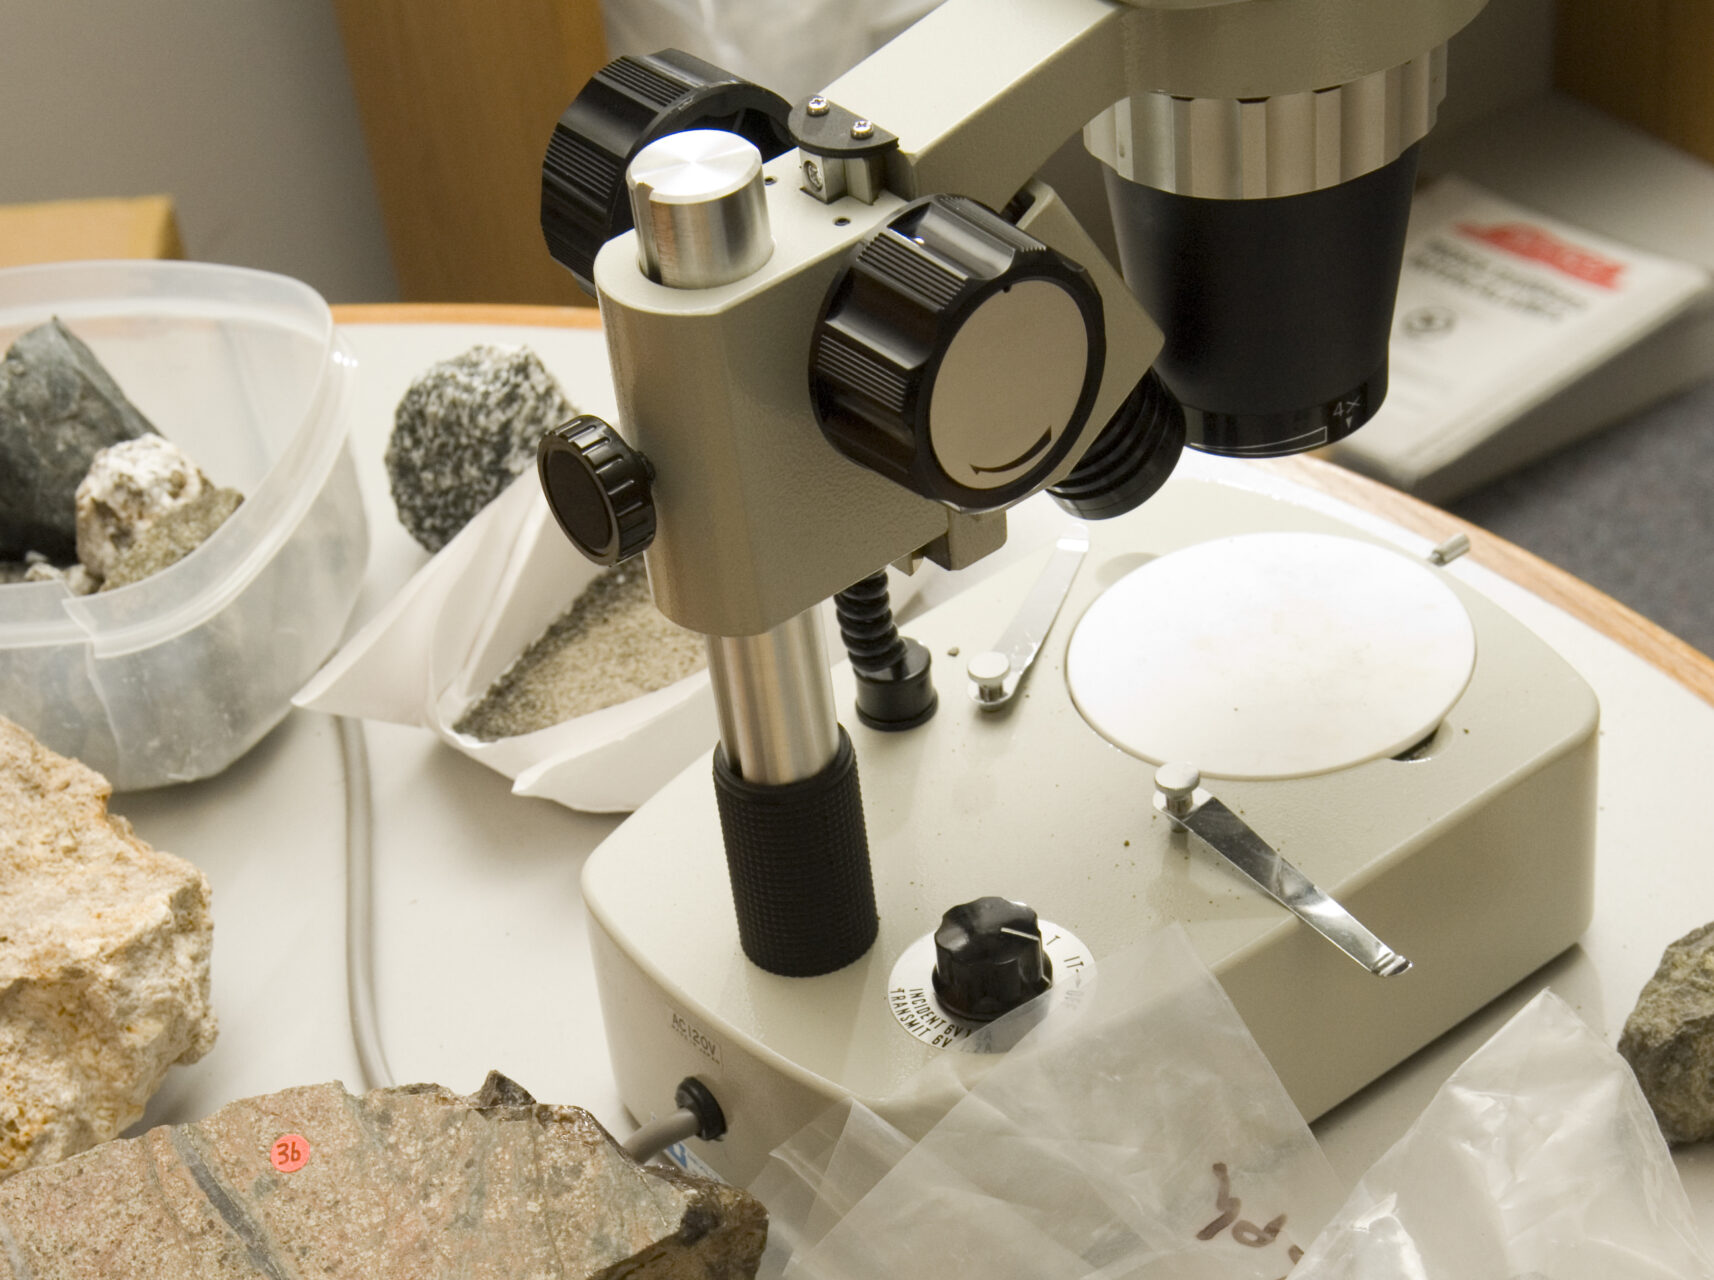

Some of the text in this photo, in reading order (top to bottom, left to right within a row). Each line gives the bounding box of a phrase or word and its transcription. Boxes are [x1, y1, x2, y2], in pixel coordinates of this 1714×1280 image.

[890, 988, 952, 1048] TRANSMIT 6V
[909, 988, 946, 1029] INCIDENT
[944, 1024, 963, 1037] 6V
